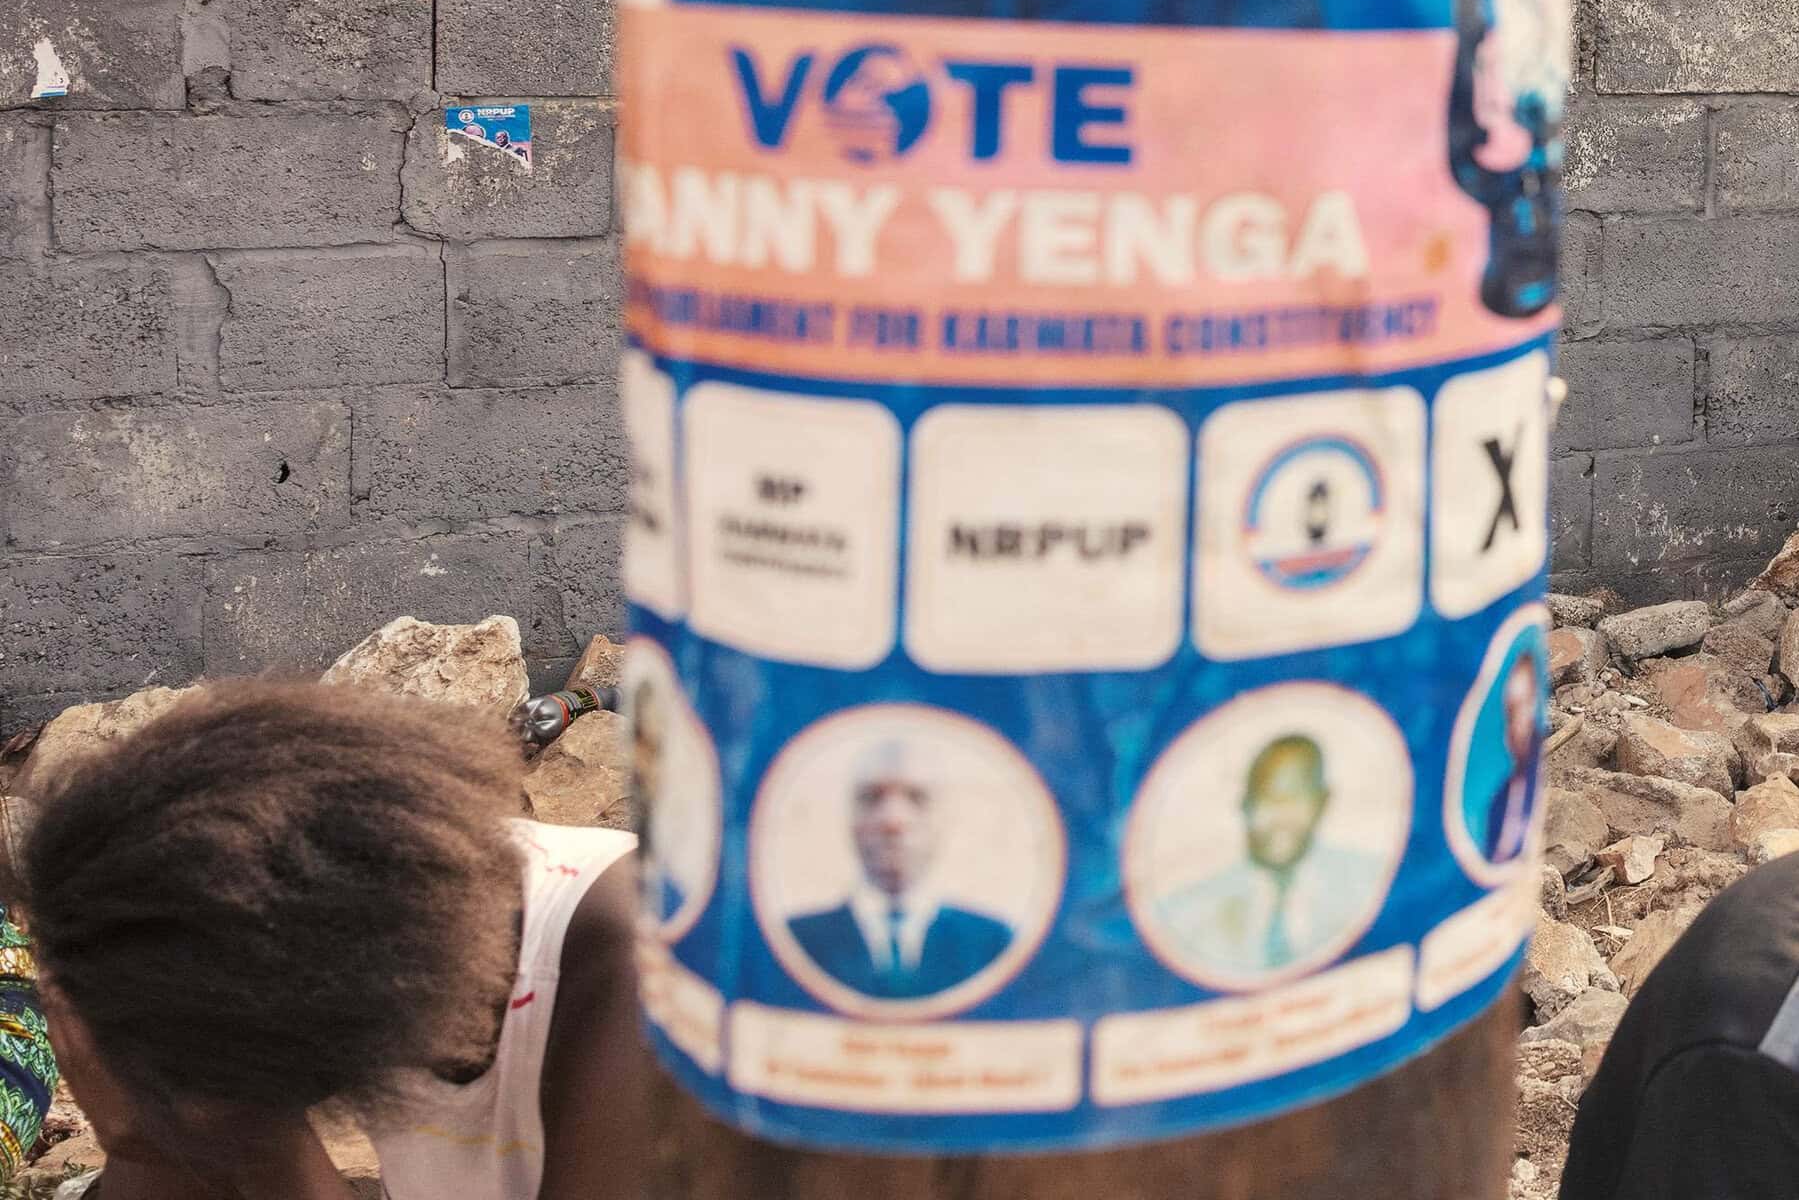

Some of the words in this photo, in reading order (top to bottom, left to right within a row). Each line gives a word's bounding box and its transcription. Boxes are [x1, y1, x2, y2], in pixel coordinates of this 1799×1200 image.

[477, 108, 516, 116] NRPUP
[729, 44, 1136, 165] VOTE
[930, 188, 1368, 286] YENGA
[848, 305, 922, 349] FOR
[947, 520, 1153, 562] NRPUP
